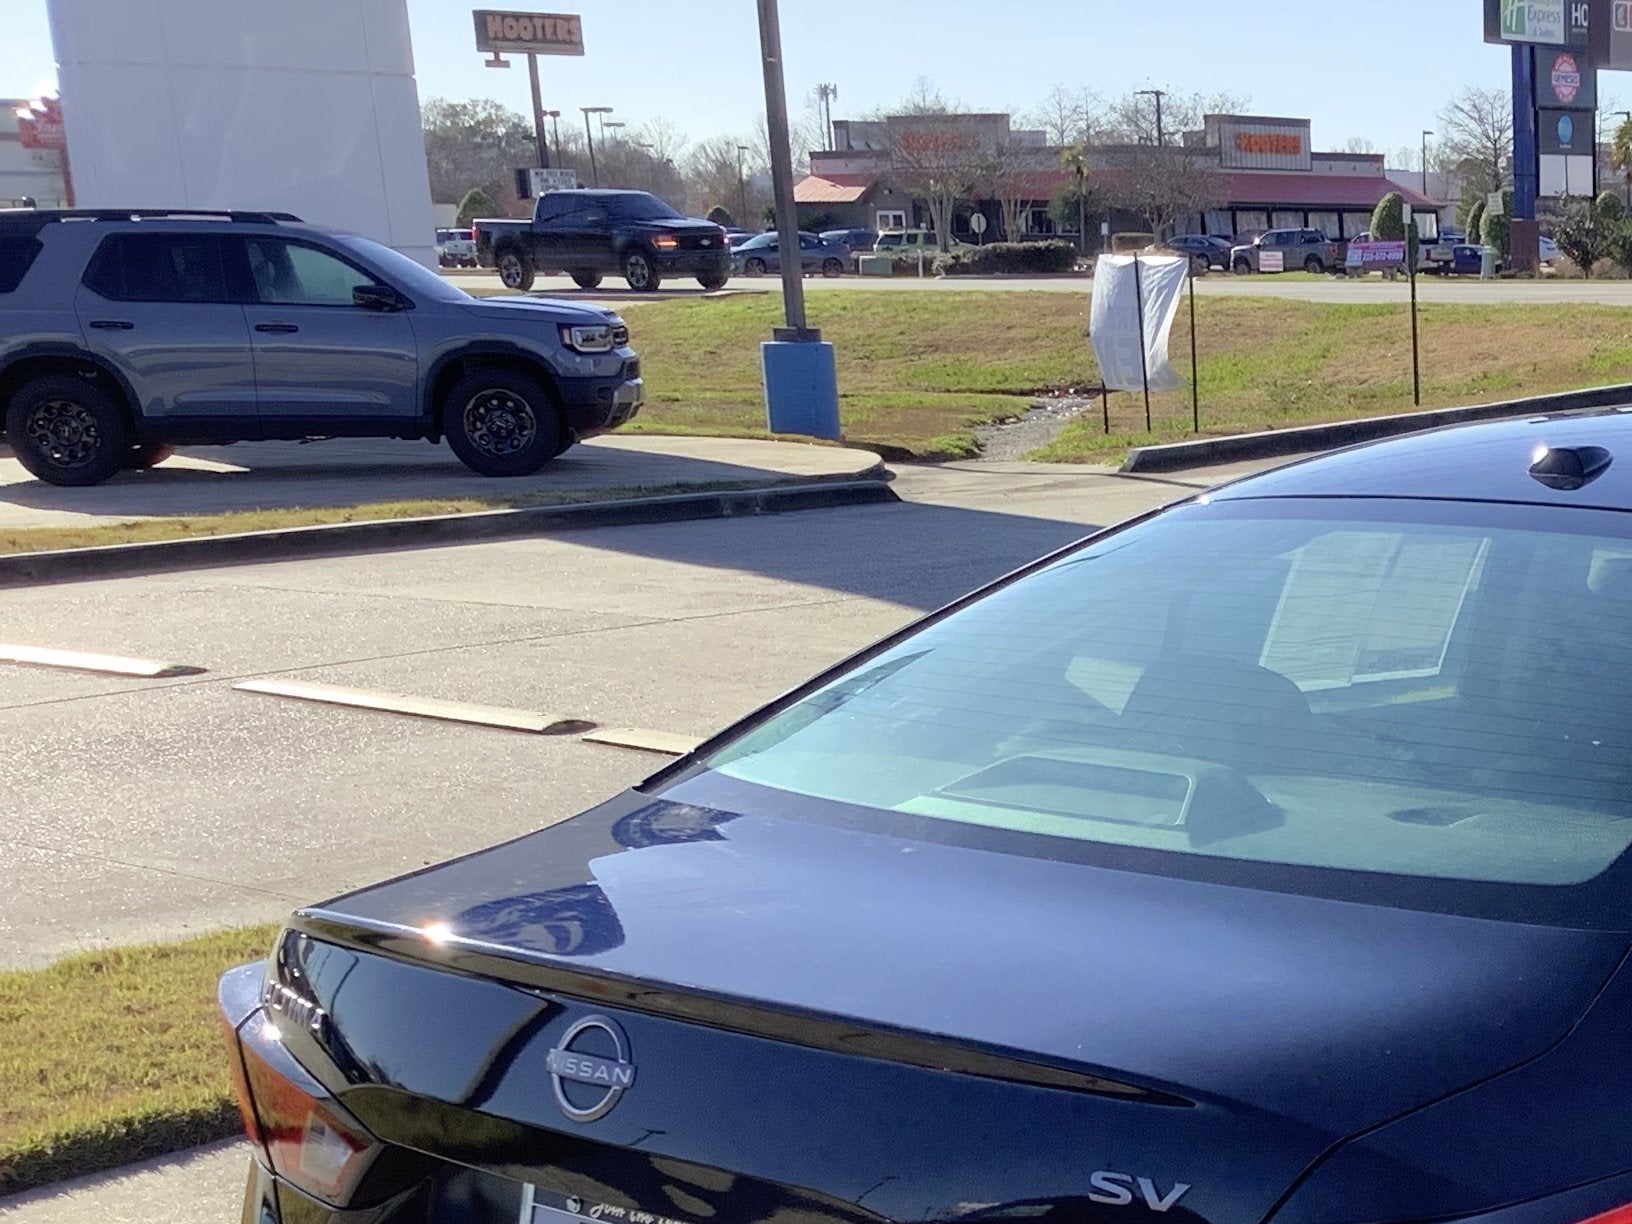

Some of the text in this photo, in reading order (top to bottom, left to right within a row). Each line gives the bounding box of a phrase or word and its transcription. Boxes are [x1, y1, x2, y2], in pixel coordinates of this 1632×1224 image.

[486, 14, 577, 42] HOOTERS
[1527, 5, 1561, 25] Express
[547, 1050, 632, 1085] NISSAN
[1088, 1170, 1192, 1212] SV
